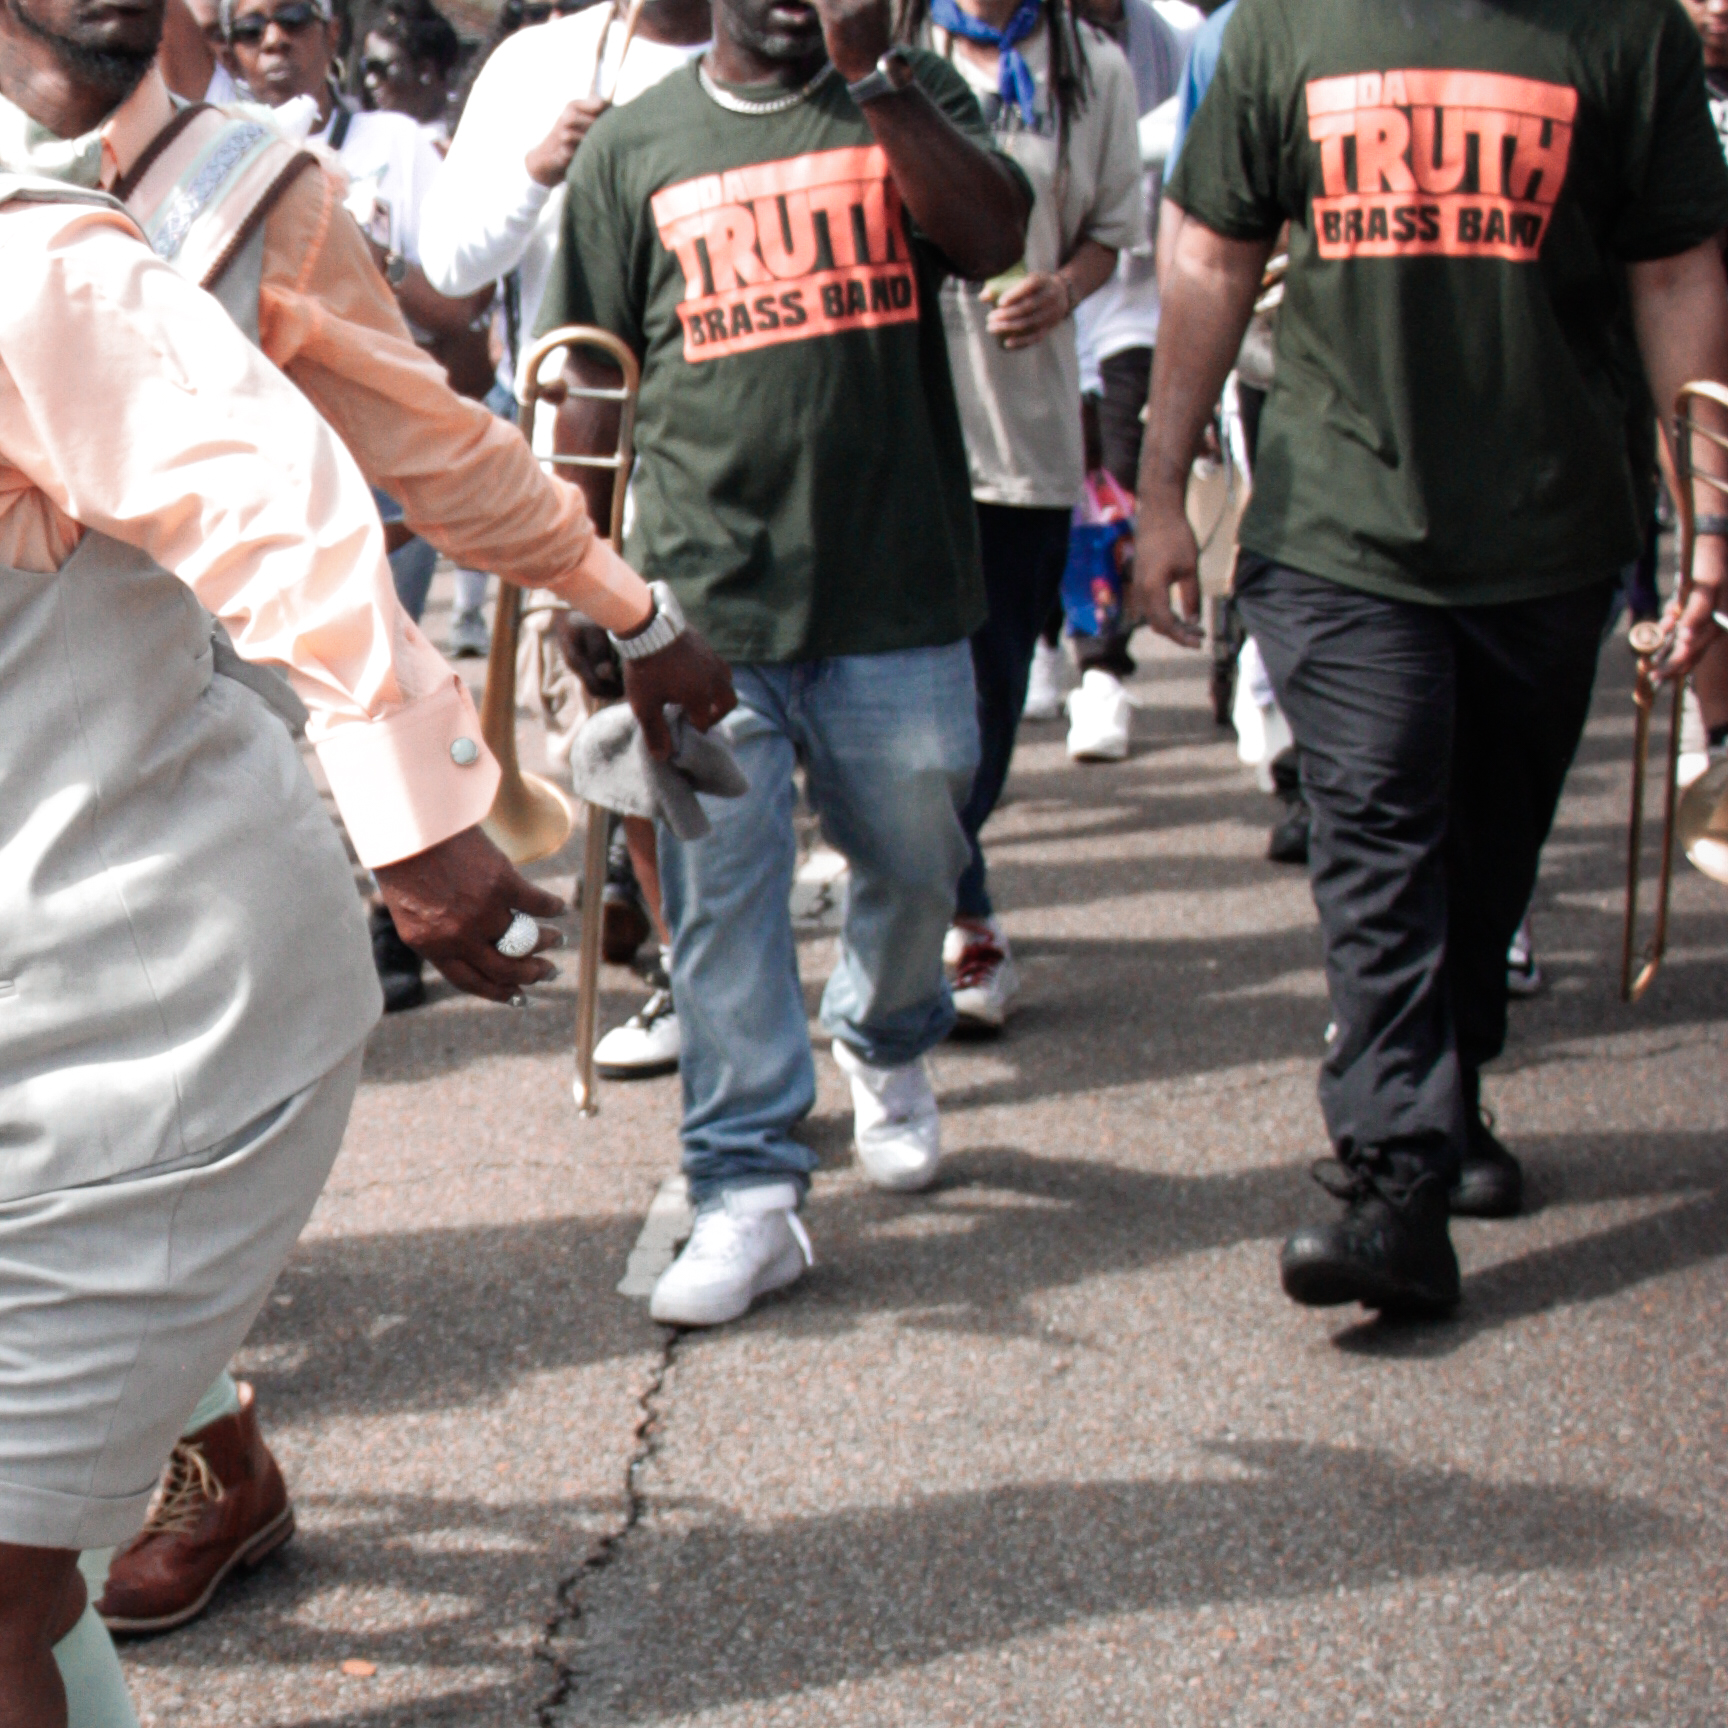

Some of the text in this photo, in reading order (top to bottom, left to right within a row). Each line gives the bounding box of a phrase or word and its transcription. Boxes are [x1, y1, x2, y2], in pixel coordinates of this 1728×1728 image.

[1356, 71, 1407, 106] DA
[1308, 106, 1572, 204] TRUTH
[698, 170, 747, 209] DA
[658, 180, 912, 300] TRUTH
[1323, 205, 1440, 243] BRASS
[687, 274, 912, 346] BRASS BAND
